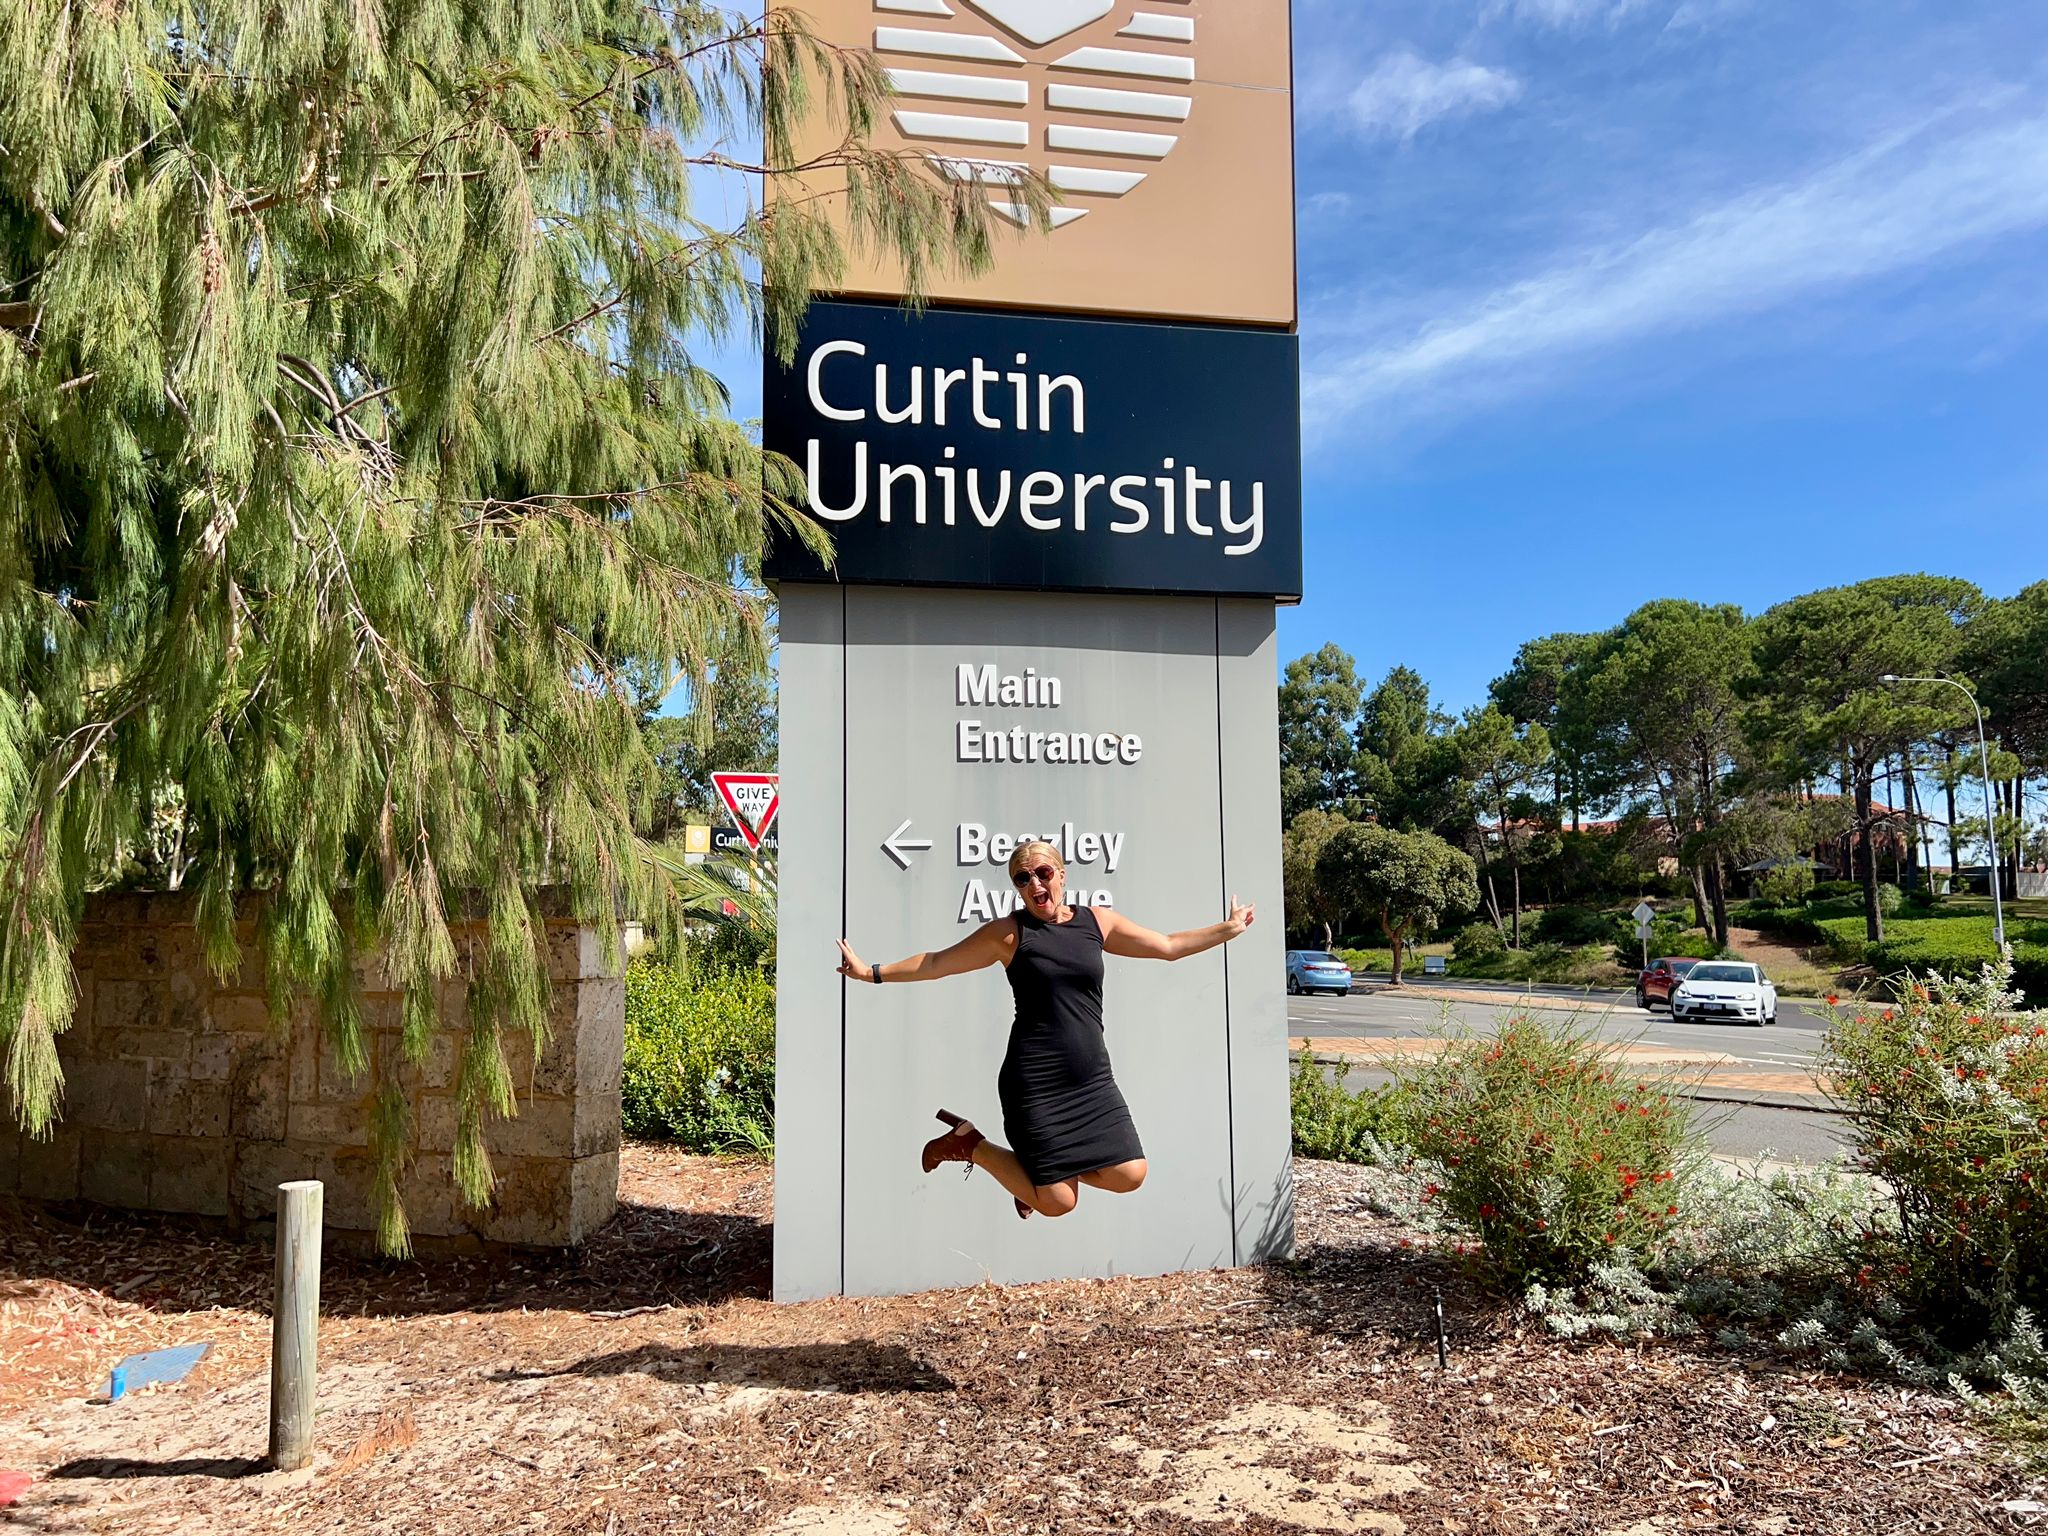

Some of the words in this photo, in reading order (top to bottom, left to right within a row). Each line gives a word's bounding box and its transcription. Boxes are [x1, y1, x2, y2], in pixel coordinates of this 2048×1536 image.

[807, 340, 1084, 433] Curtin
[807, 438, 1264, 556] University
[957, 663, 1061, 706] Main
[957, 719, 1143, 763] Entrance
[736, 787, 770, 800] GIVE
[742, 802, 766, 813] WAY
[715, 833, 747, 847] Curt
[959, 879, 1113, 920] Avue
